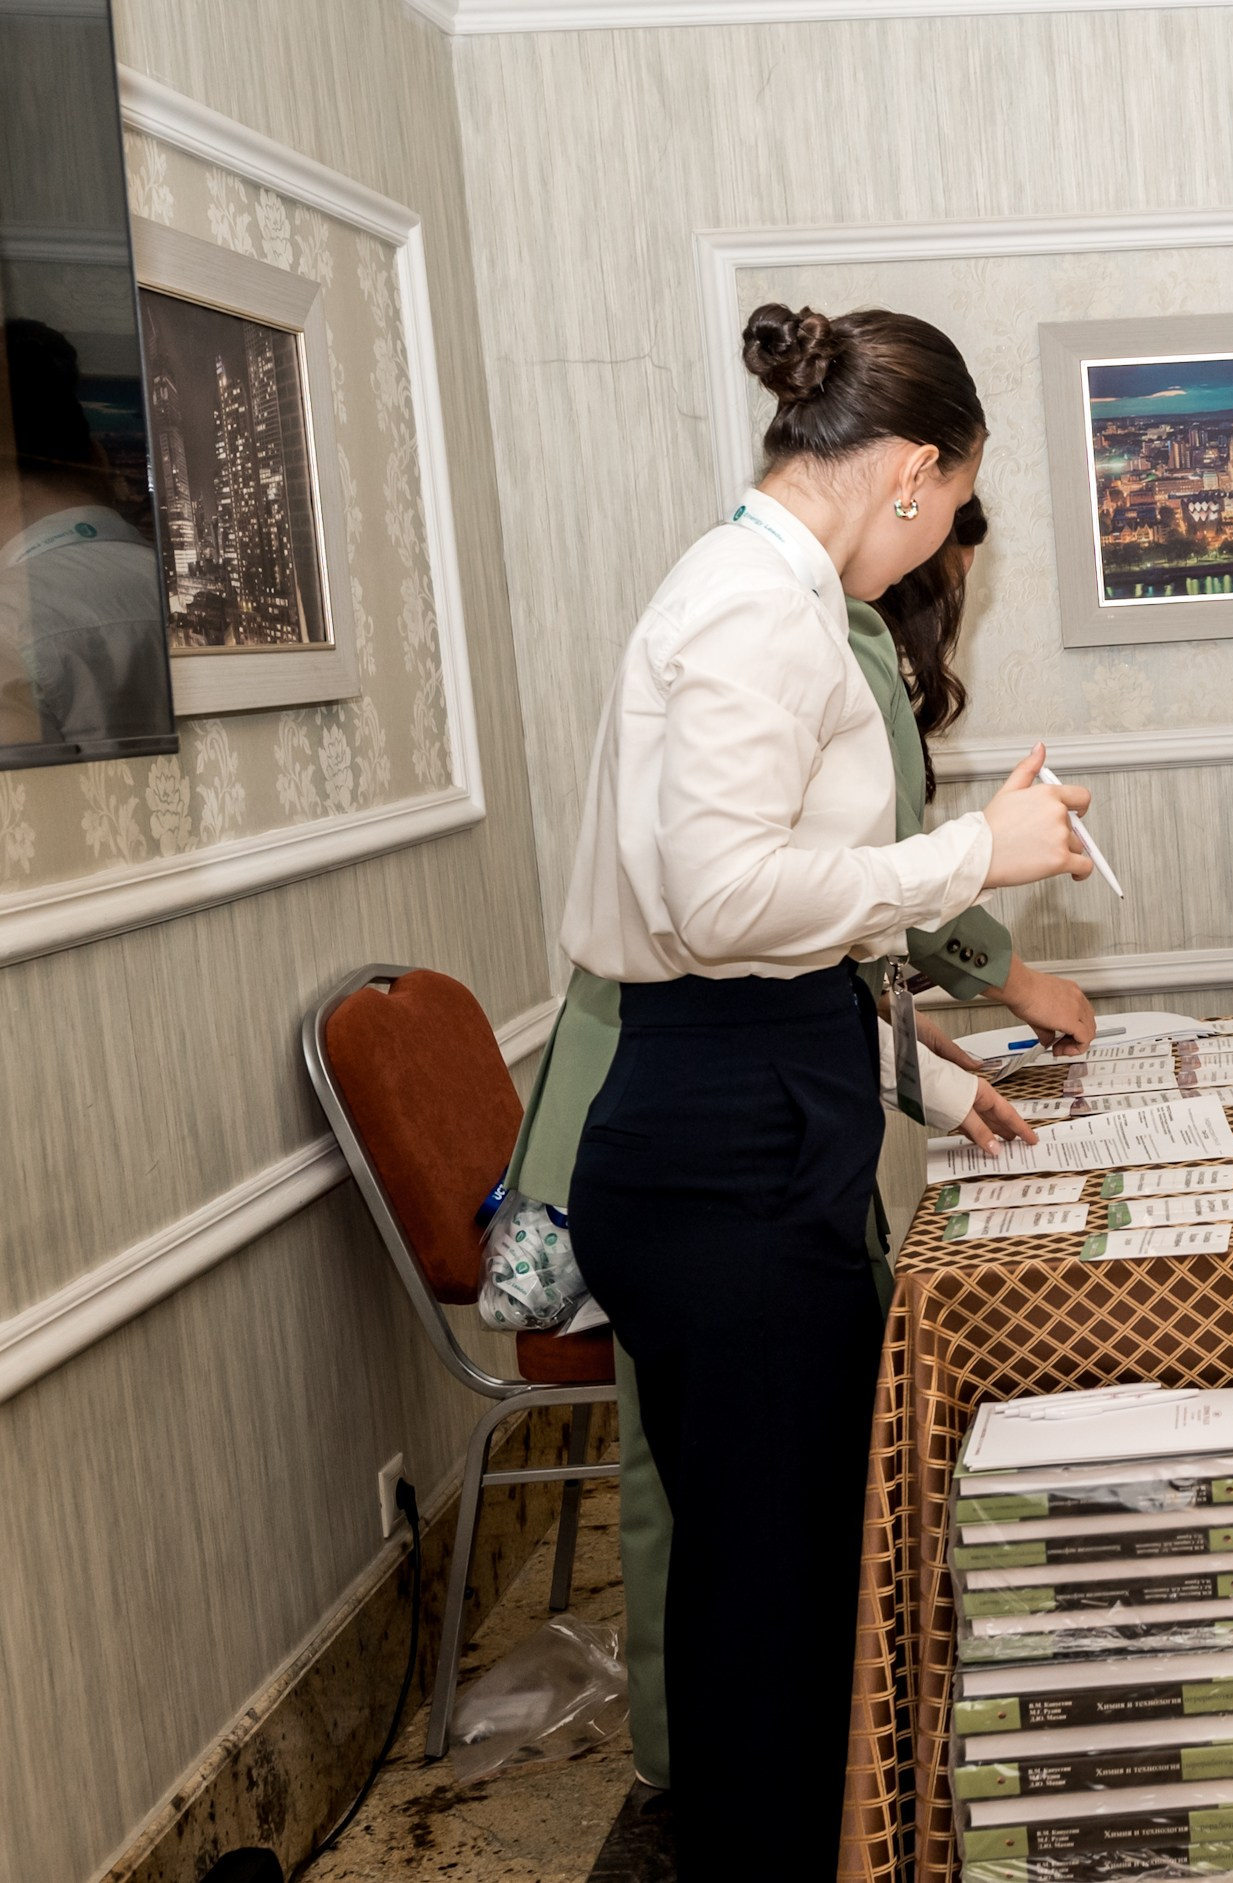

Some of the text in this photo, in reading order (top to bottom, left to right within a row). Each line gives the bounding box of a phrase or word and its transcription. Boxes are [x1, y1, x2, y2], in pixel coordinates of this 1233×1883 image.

[1097, 1701, 1125, 1711] Химия
[1135, 1697, 1182, 1708] технология
[1096, 1767, 1124, 1777] Химия
[1133, 1763, 1180, 1773] технология
[1104, 1829, 1133, 1839] Химия
[1142, 1825, 1188, 1836] технология
